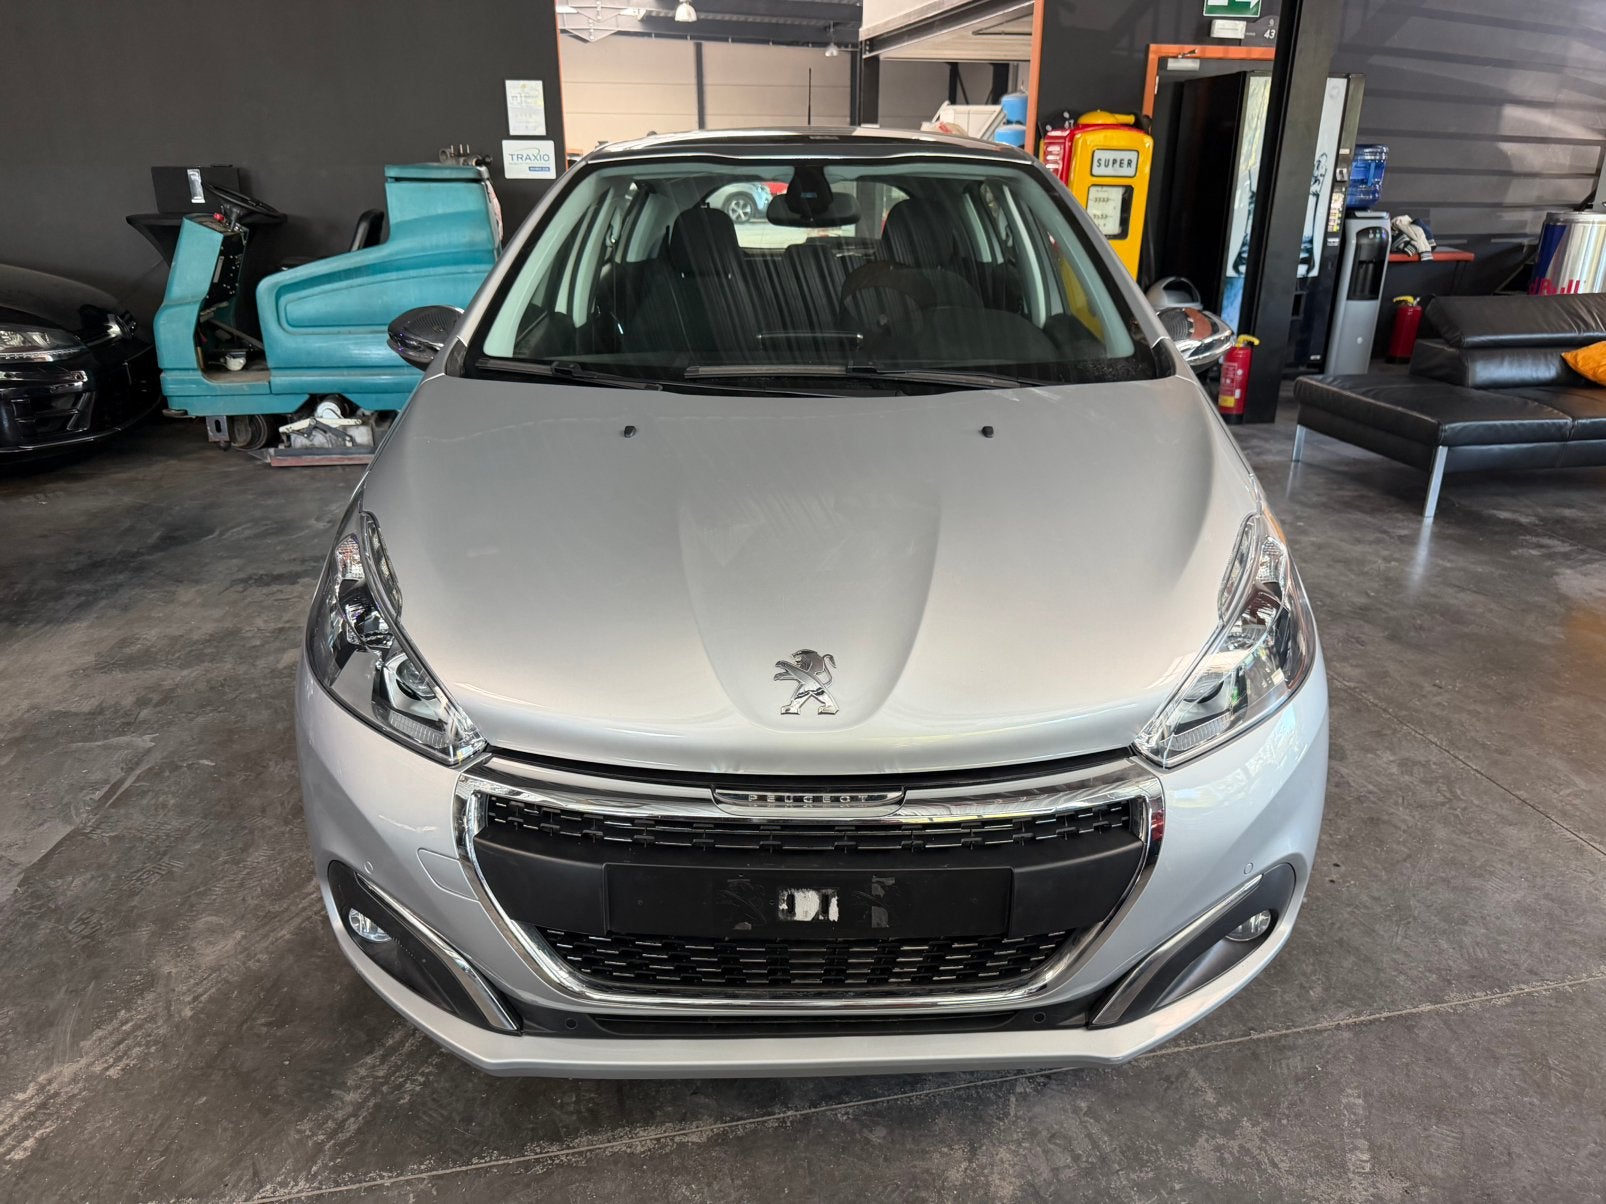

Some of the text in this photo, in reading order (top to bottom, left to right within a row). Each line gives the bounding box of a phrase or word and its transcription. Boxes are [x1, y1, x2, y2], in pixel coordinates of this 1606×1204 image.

[1264, 28, 1276, 40] 43
[509, 153, 550, 162] TRAXIO
[1096, 158, 1133, 168] SUPER
[748, 794, 868, 803] PEUGEOT
